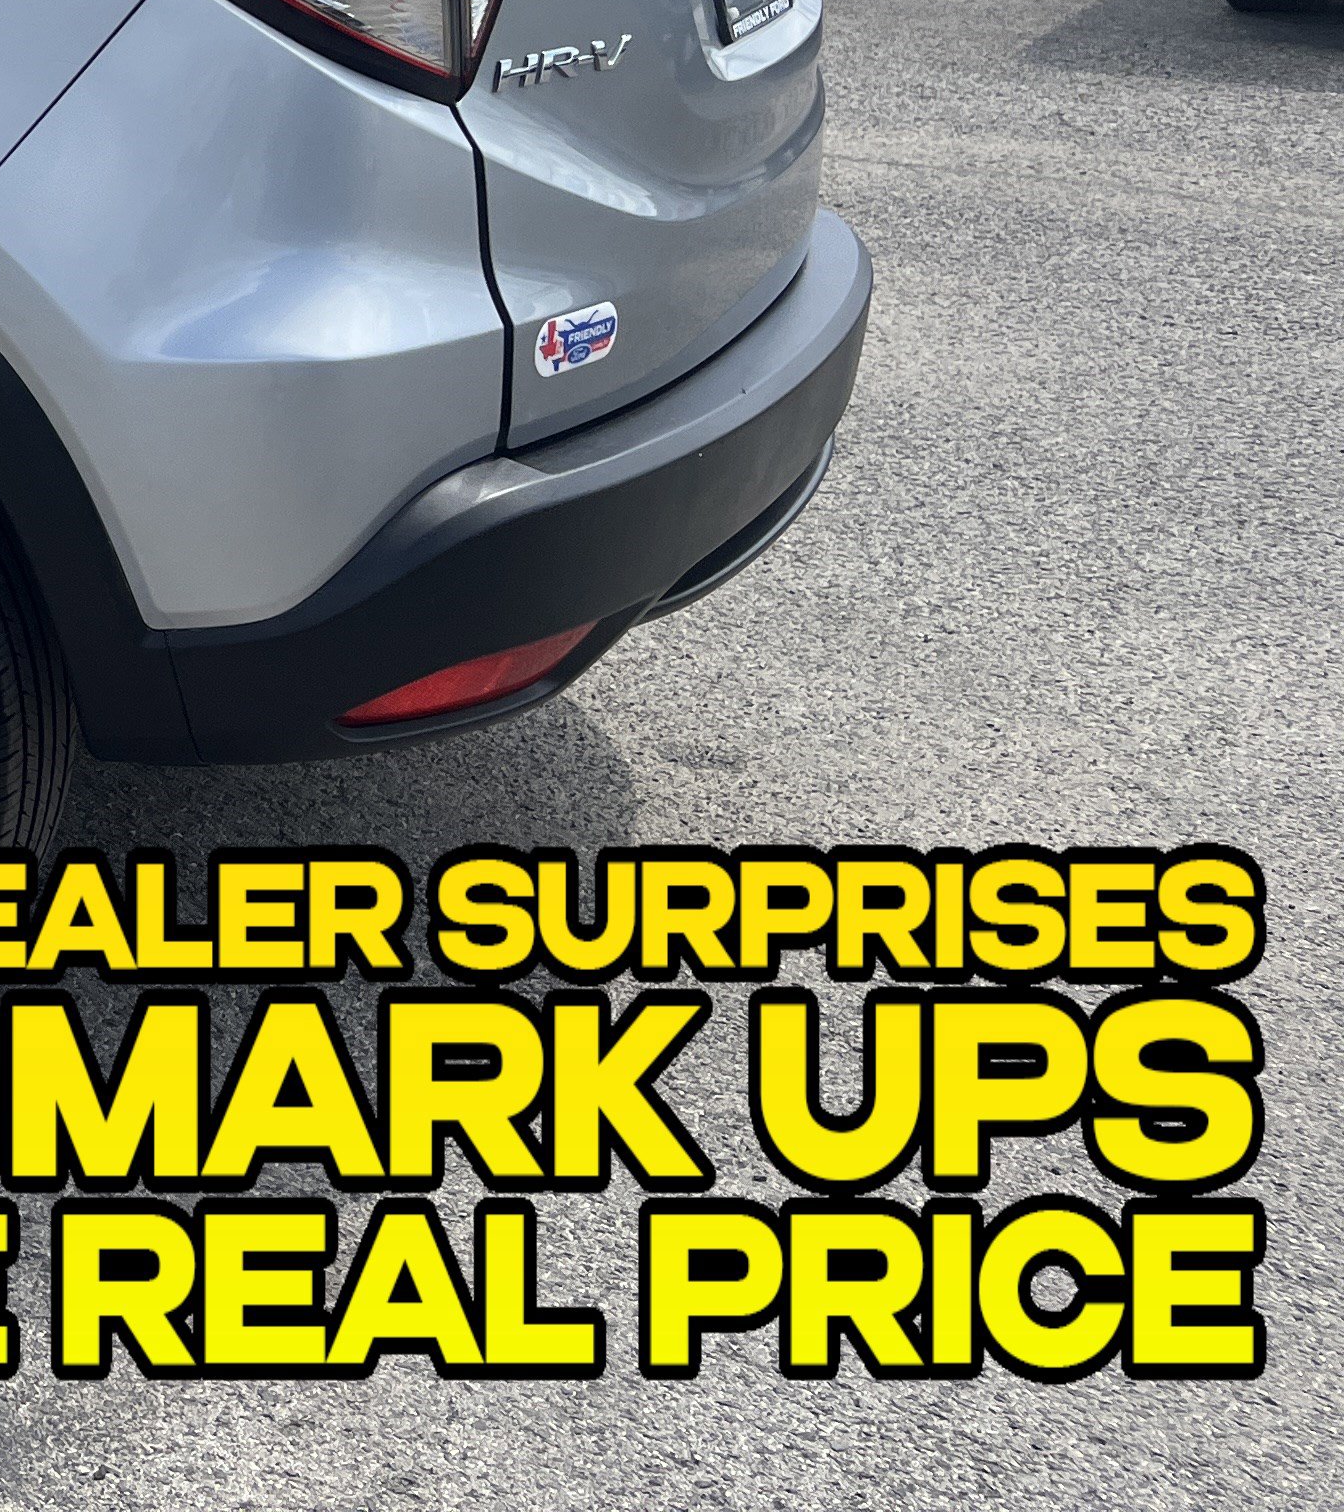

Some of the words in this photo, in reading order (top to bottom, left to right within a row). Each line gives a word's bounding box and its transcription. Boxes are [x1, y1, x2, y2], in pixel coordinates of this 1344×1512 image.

[732, 5, 769, 39] FRIENDLY
[492, 34, 632, 93] HR-V
[568, 320, 613, 345] FRIENDLY
